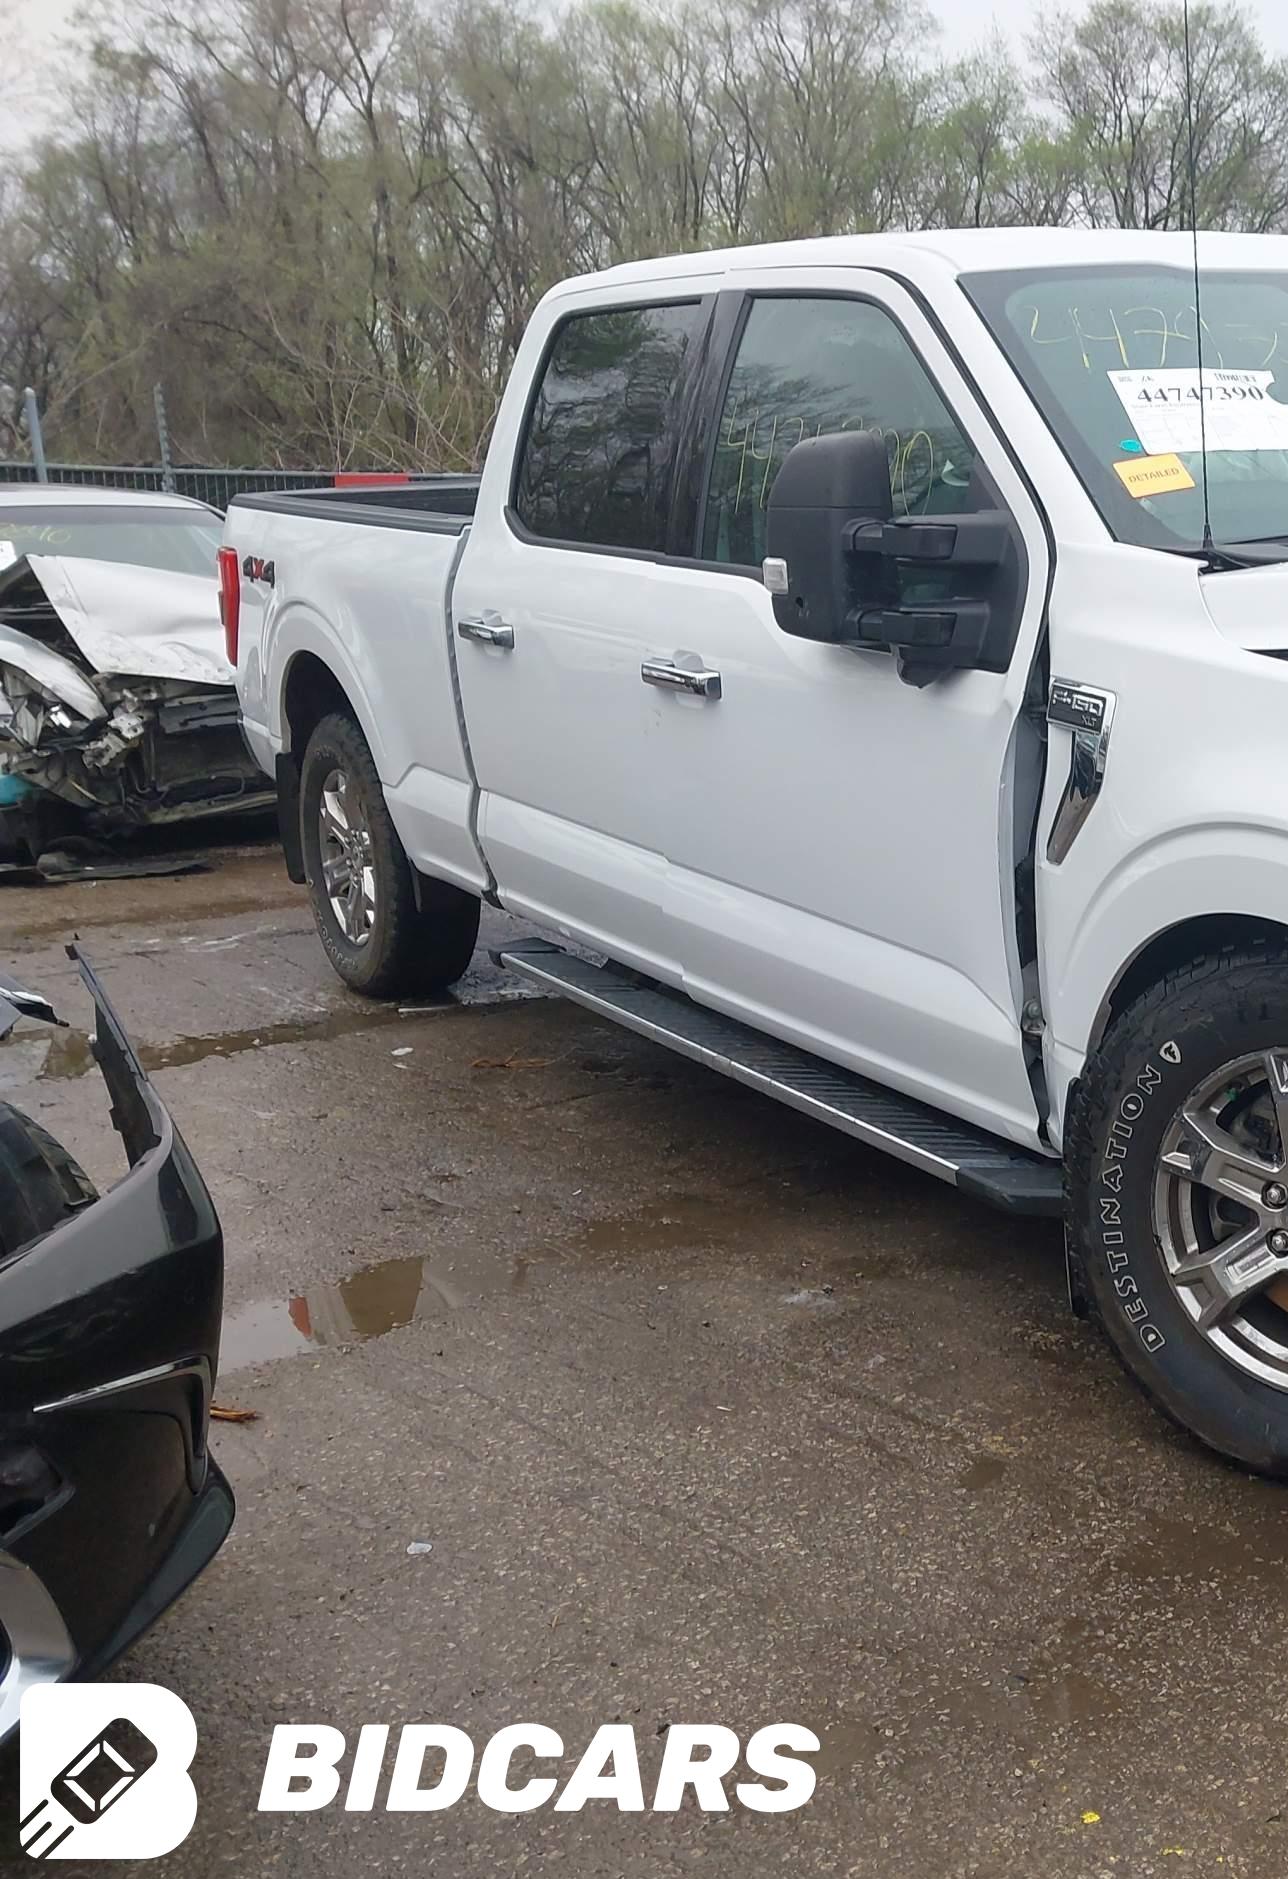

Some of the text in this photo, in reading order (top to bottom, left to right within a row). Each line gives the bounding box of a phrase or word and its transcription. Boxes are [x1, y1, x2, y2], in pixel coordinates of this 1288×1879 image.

[1137, 384, 1265, 403] 44747390
[1128, 467, 1181, 484] DETAILED
[1101, 1063, 1167, 1353] DESTINATION
